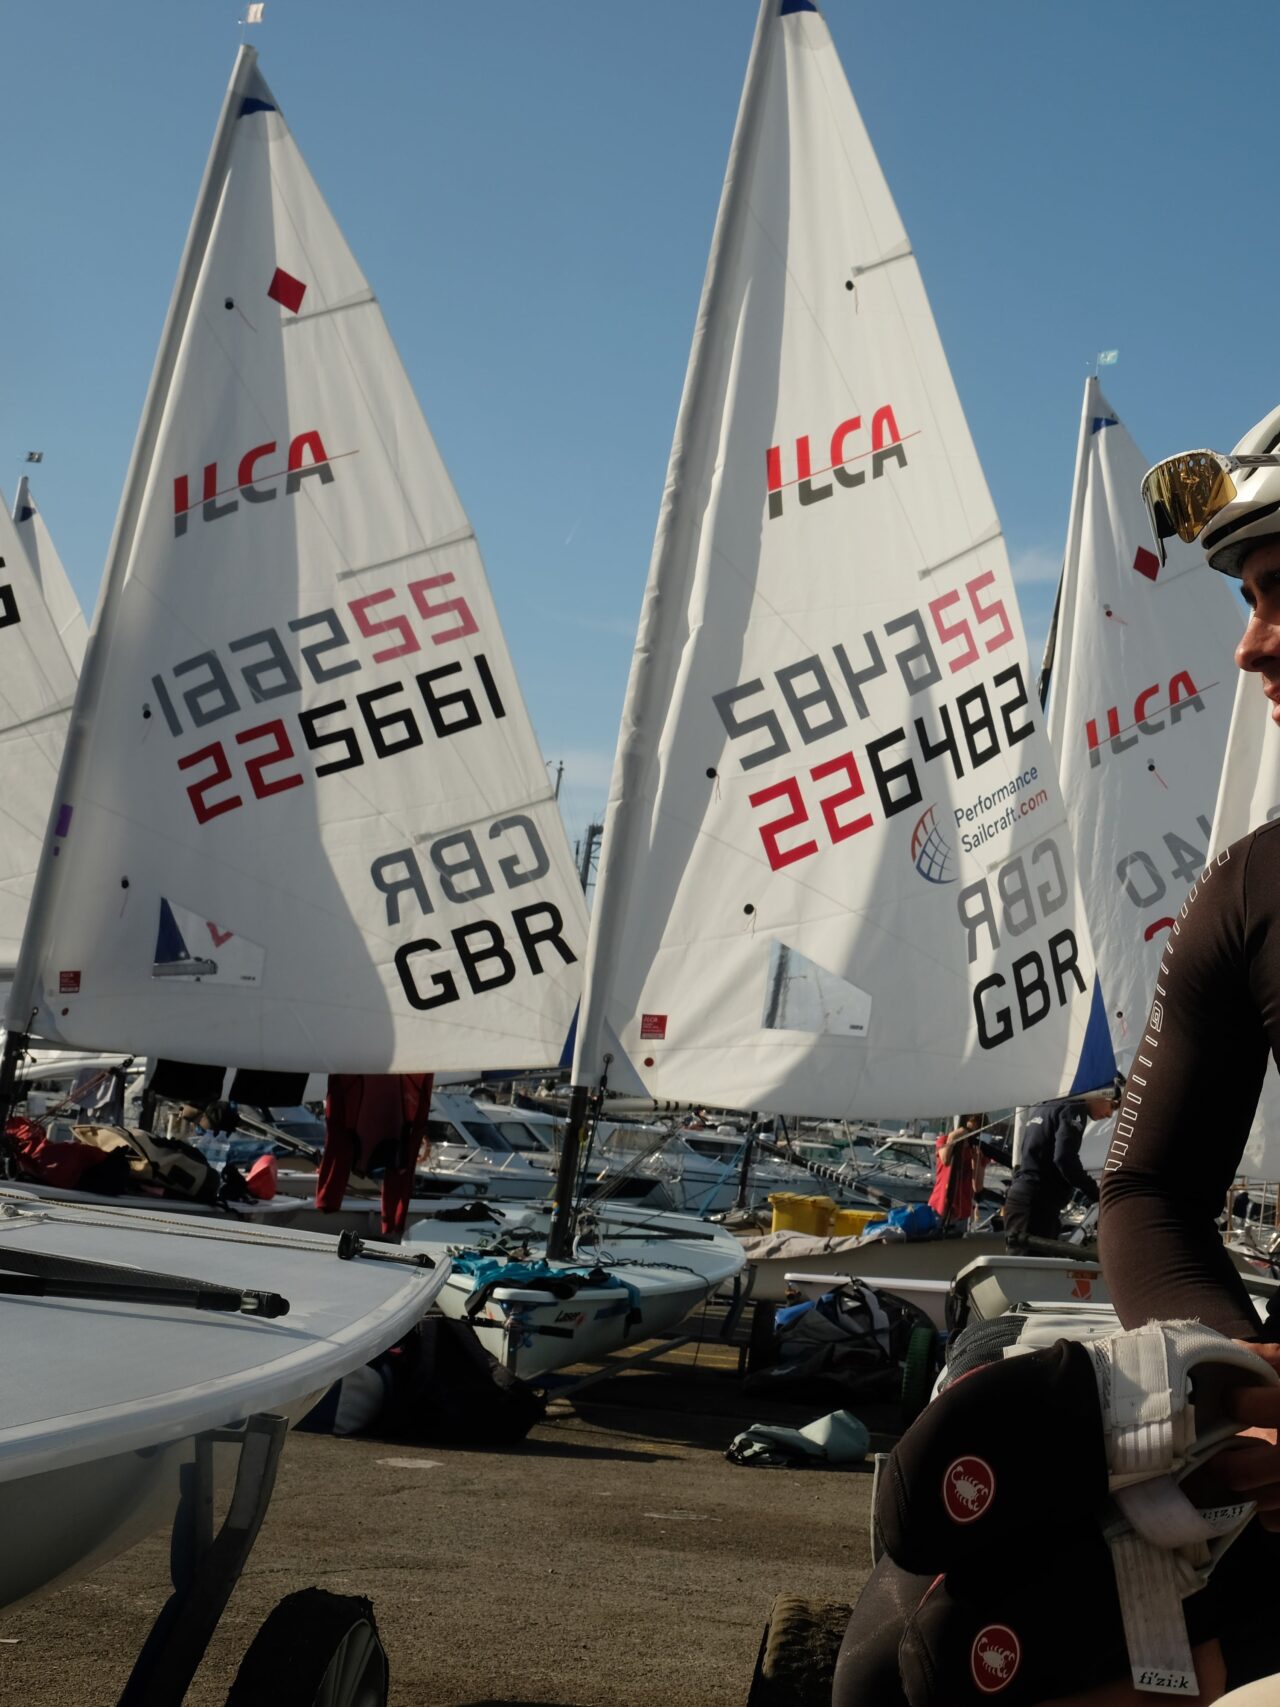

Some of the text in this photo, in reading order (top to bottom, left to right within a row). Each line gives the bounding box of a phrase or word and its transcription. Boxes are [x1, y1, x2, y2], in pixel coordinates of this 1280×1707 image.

[173, 430, 335, 538] ILCA
[766, 404, 908, 520] ILCA
[177, 653, 506, 825] 225661
[748, 662, 1036, 872] 226482
[1085, 669, 1205, 769] ILCA
[954, 766, 1039, 828] Performance
[961, 789, 1048, 853] Sailcraft.com
[394, 900, 578, 1011] GBR
[973, 928, 1088, 1050] GBR
